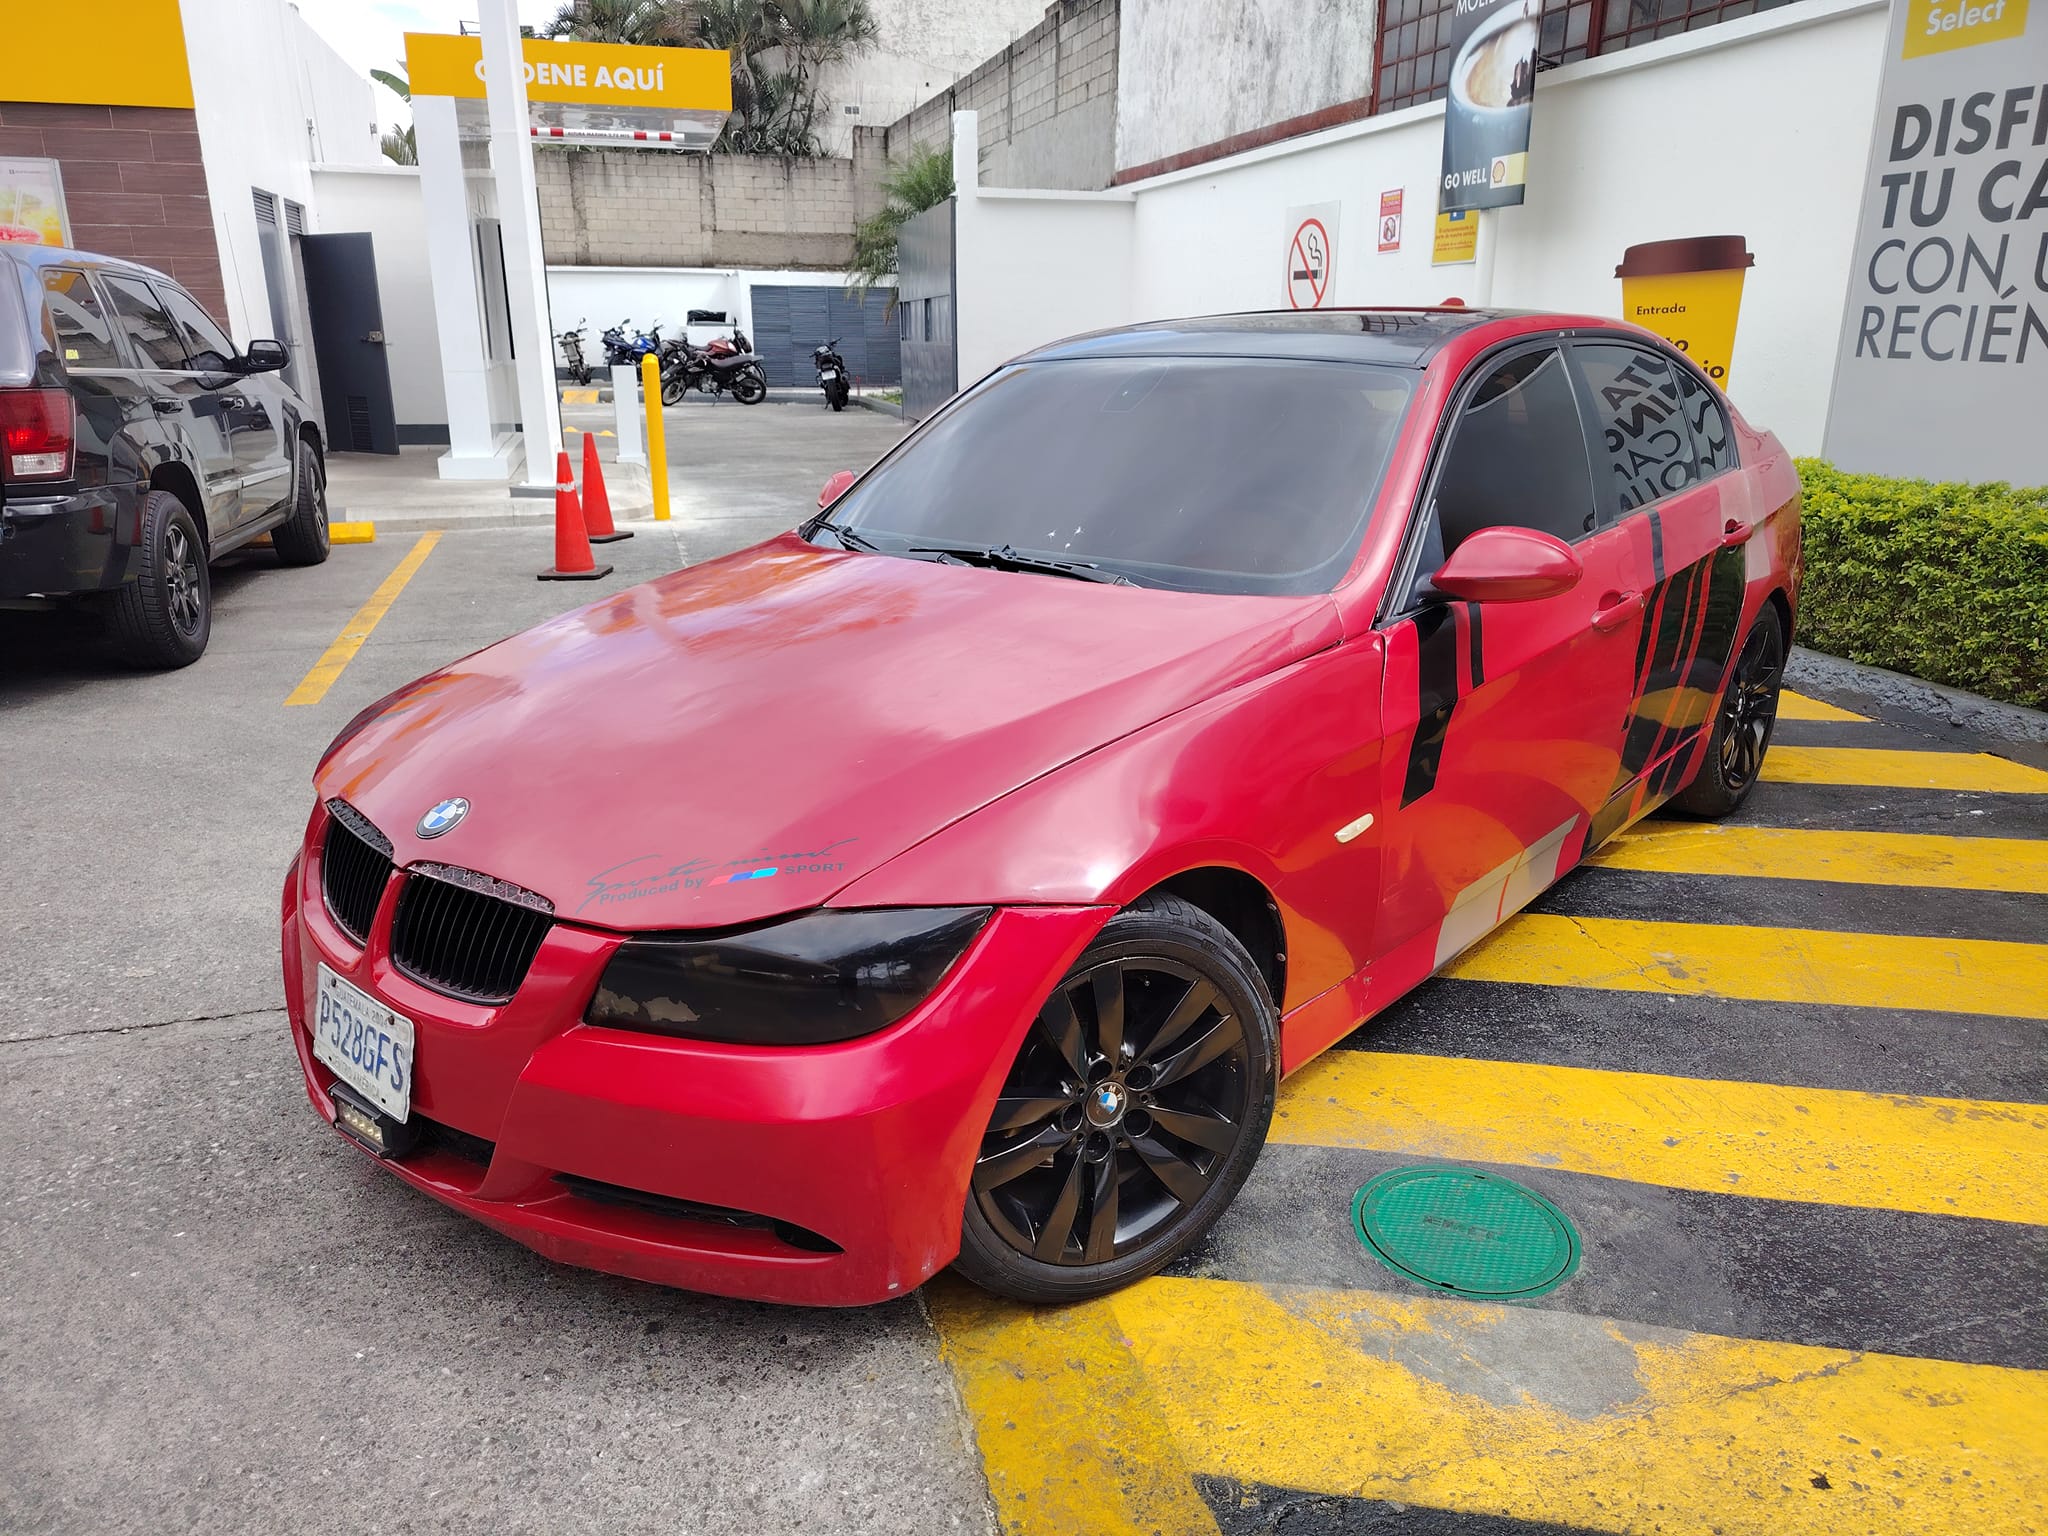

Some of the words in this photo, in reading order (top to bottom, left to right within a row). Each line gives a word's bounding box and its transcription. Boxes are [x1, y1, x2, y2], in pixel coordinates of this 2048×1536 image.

[594, 62, 664, 91] AQUÍ
[1444, 173, 1460, 190] GO
[1462, 168, 1487, 186] WELL
[1880, 167, 1955, 229] TU
[1868, 232, 2010, 295] CON
[1636, 303, 1686, 316] Entrada
[784, 862, 846, 876] SPORT
[600, 877, 679, 905] Produced
[683, 876, 704, 891] by
[320, 990, 404, 1091] P528GFS
